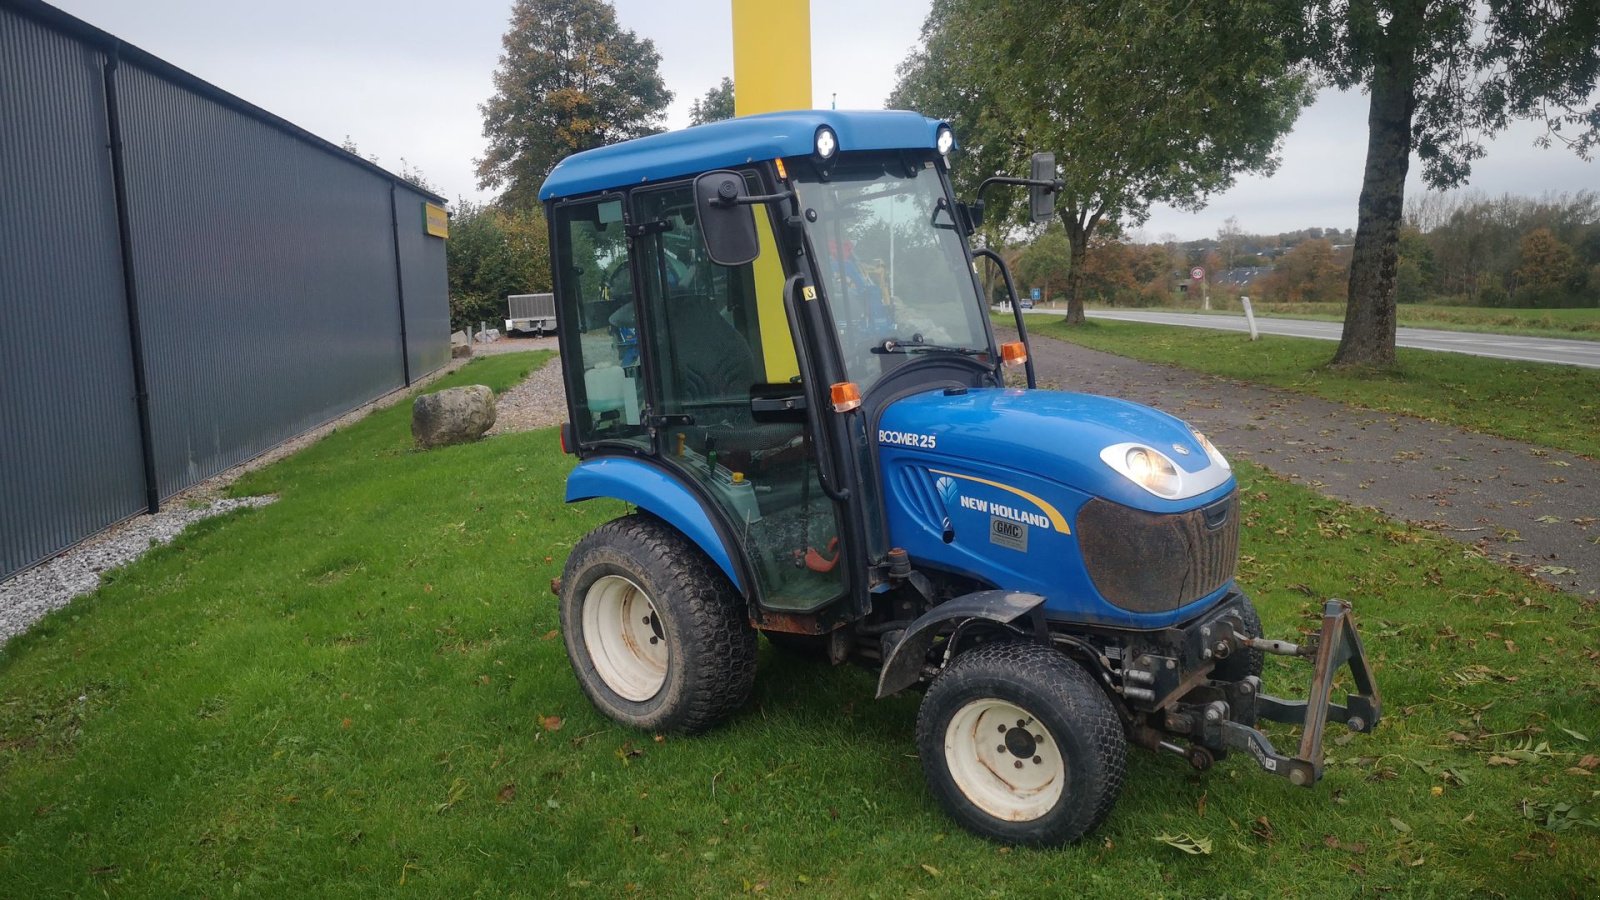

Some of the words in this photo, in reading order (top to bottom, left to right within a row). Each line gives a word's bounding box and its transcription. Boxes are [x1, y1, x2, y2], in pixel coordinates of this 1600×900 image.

[960, 495, 988, 513] NEW
[989, 502, 1050, 529] HOLLAND
[997, 521, 1019, 537] GMC
